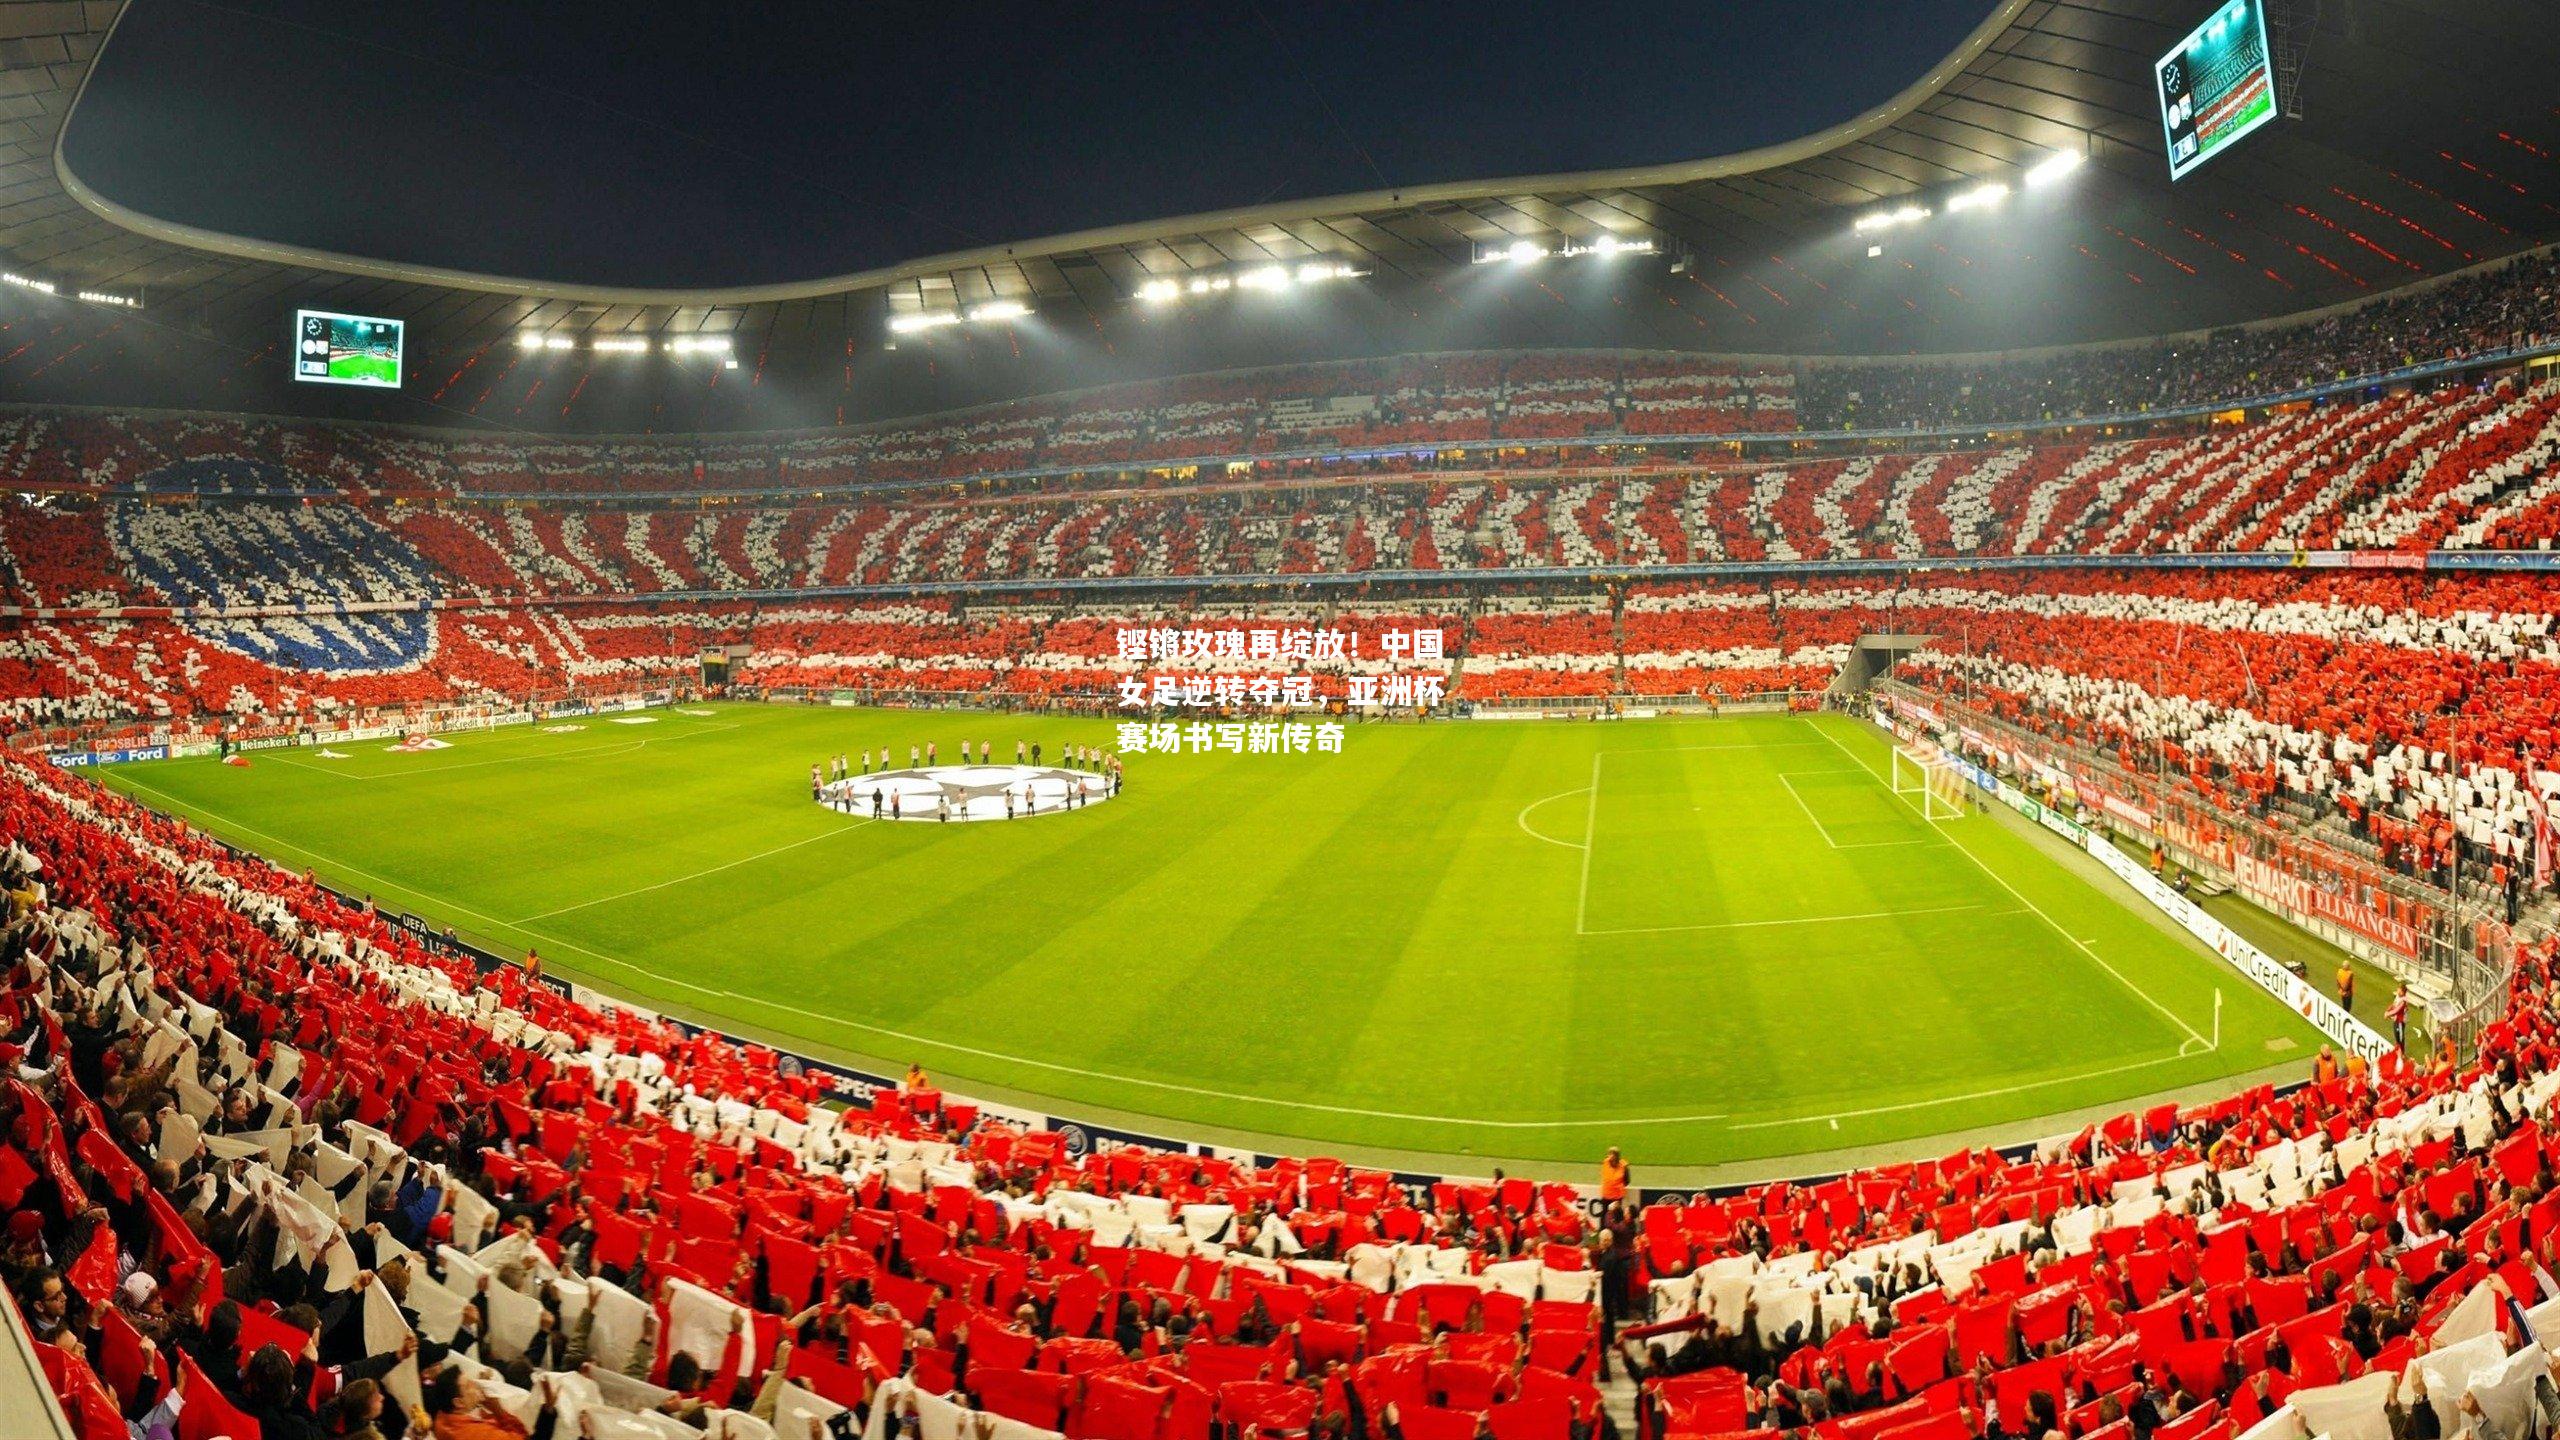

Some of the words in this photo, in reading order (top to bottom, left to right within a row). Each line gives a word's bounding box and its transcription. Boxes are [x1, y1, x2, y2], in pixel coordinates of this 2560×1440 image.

[51, 754, 88, 768] Ford
[128, 747, 163, 761] Ford
[240, 737, 288, 751] Heineken
[2234, 852, 2312, 914] NEUMARKT
[403, 915, 428, 935] UEFA
[2316, 889, 2415, 952] ELLWANGEN
[2230, 937, 2290, 1001] UniCredit
[2316, 996, 2389, 1062] UniCredi
